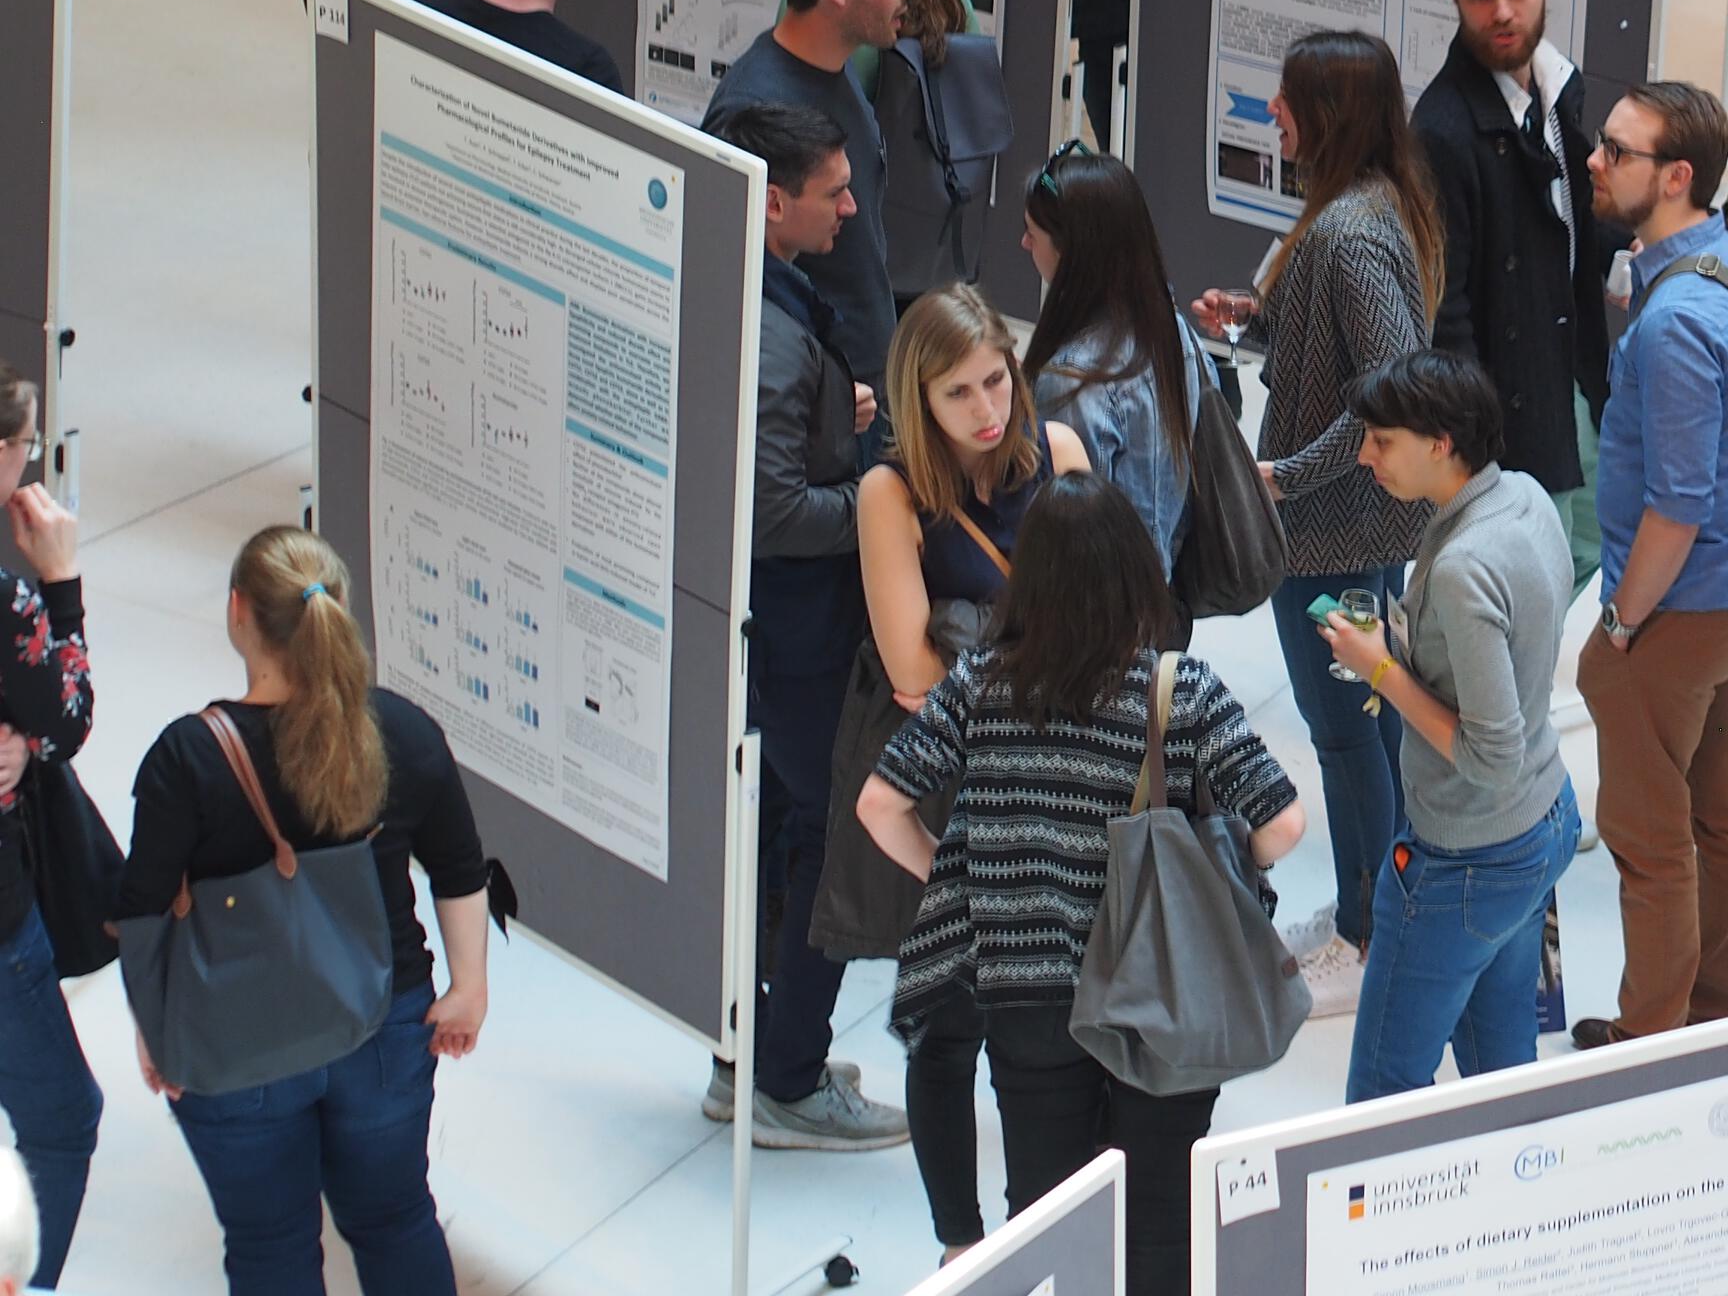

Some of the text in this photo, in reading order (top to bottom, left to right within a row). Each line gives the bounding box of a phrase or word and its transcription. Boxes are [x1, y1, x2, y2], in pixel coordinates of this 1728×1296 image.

[319, 4, 345, 26] P 114
[516, 139, 526, 151] for
[556, 157, 591, 182] Treatment
[570, 149, 585, 163] with
[1229, 1171, 1268, 1197] P 44
[1373, 1158, 1481, 1197] universität
[1373, 1180, 1469, 1217] innsbruck
[1360, 1259, 1389, 1276] The
[1394, 1244, 1449, 1269] effects
[1455, 1237, 1471, 1253] of
[1476, 1224, 1532, 1250] dietary
[1537, 1187, 1671, 1235] supplementation
[1676, 1184, 1697, 1200] on
[1701, 1172, 1725, 1195] the
